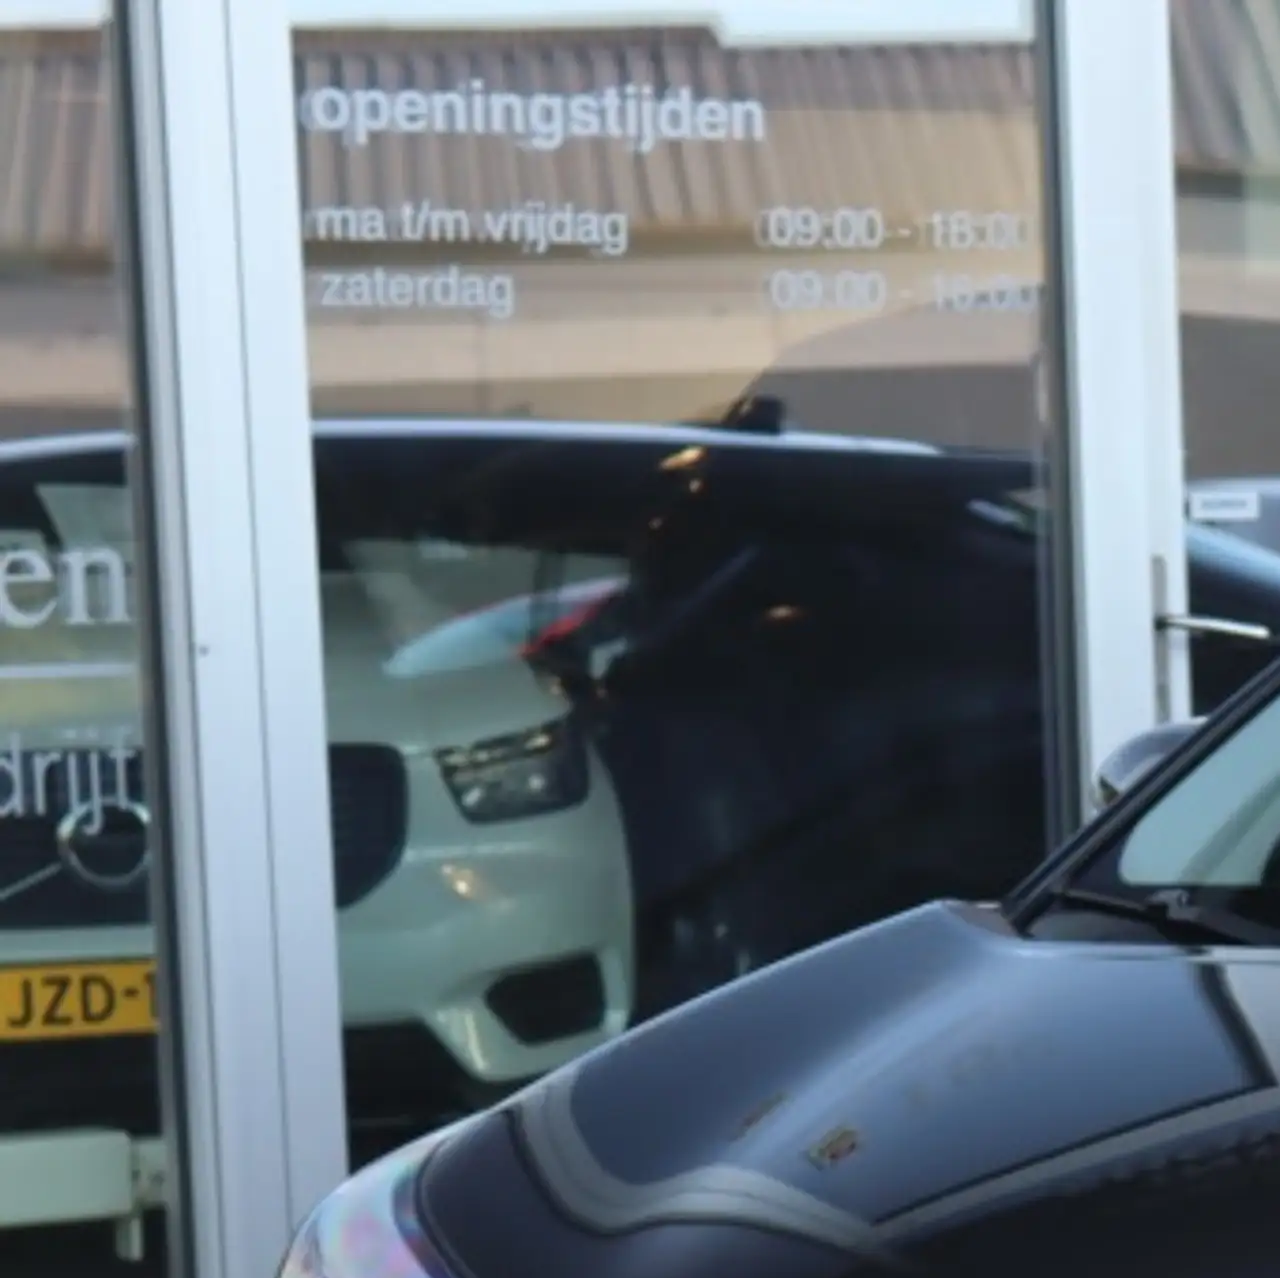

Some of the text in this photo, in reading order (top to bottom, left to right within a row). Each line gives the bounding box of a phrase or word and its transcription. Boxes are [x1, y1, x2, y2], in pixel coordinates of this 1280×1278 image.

[309, 79, 766, 153] openingstijden
[316, 207, 386, 241] ma
[402, 199, 470, 241] t/m
[484, 202, 627, 255] vrijdag
[768, 207, 884, 249] 09:00
[321, 266, 515, 319] zaterdag
